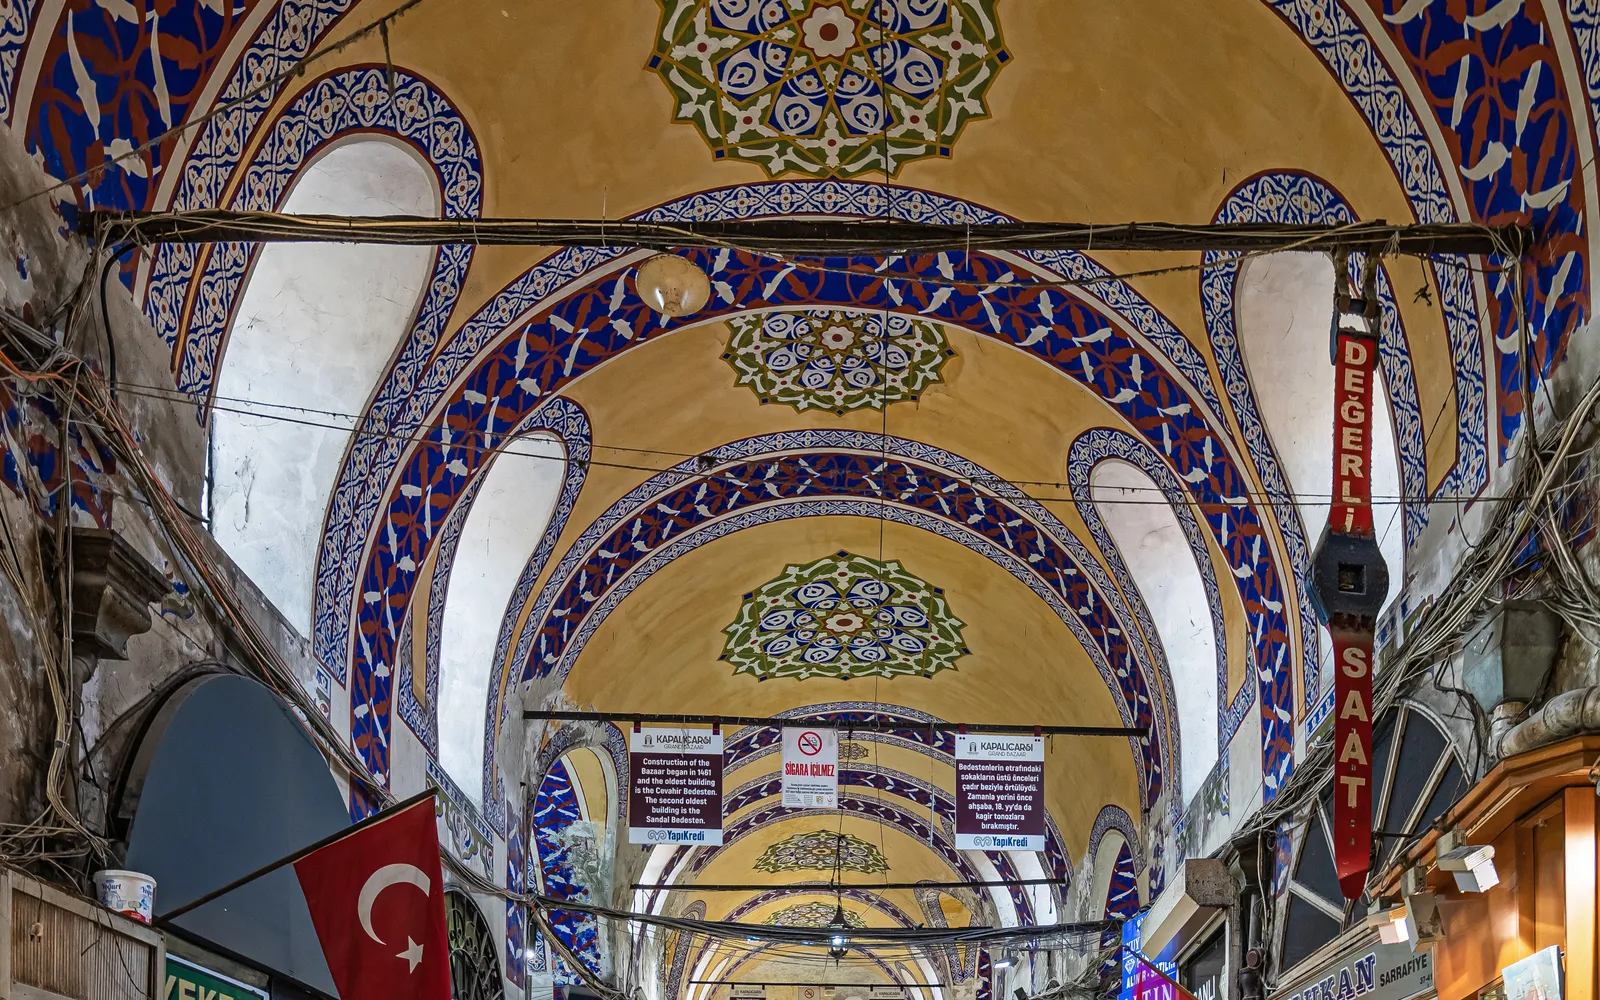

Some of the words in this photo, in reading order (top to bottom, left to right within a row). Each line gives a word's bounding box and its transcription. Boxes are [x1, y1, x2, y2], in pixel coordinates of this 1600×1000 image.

[1340, 340, 1368, 533] DEĞERLİ
[1339, 647, 1369, 808] SAAT
[643, 758, 688, 766] Construction
[785, 761, 809, 776] SİGARA
[810, 762, 835, 778] İÇİLMEZ
[958, 763, 1004, 771] Bedestenlerin
[666, 768, 688, 777] began
[961, 773, 995, 781] sokakların
[1012, 774, 1039, 782] önceleri
[688, 778, 716, 787] building
[683, 788, 718, 796] Bedesten.
[962, 783, 979, 791] çadır
[980, 784, 1004, 792] beziyle
[1004, 784, 1038, 792] örtülüydü.
[645, 796, 658, 804] The
[686, 797, 708, 805] oldest
[996, 793, 1016, 801] yerini
[652, 806, 679, 815] building
[968, 802, 994, 811] ahşaba,
[646, 815, 670, 823] Sandal
[671, 816, 706, 824] Bedesten.
[976, 812, 993, 821] kagir
[981, 822, 1020, 831] bırakmıştır.
[1379, 953, 1428, 987] SARRAFİYE
[1126, 970, 1147, 989] ALINR
